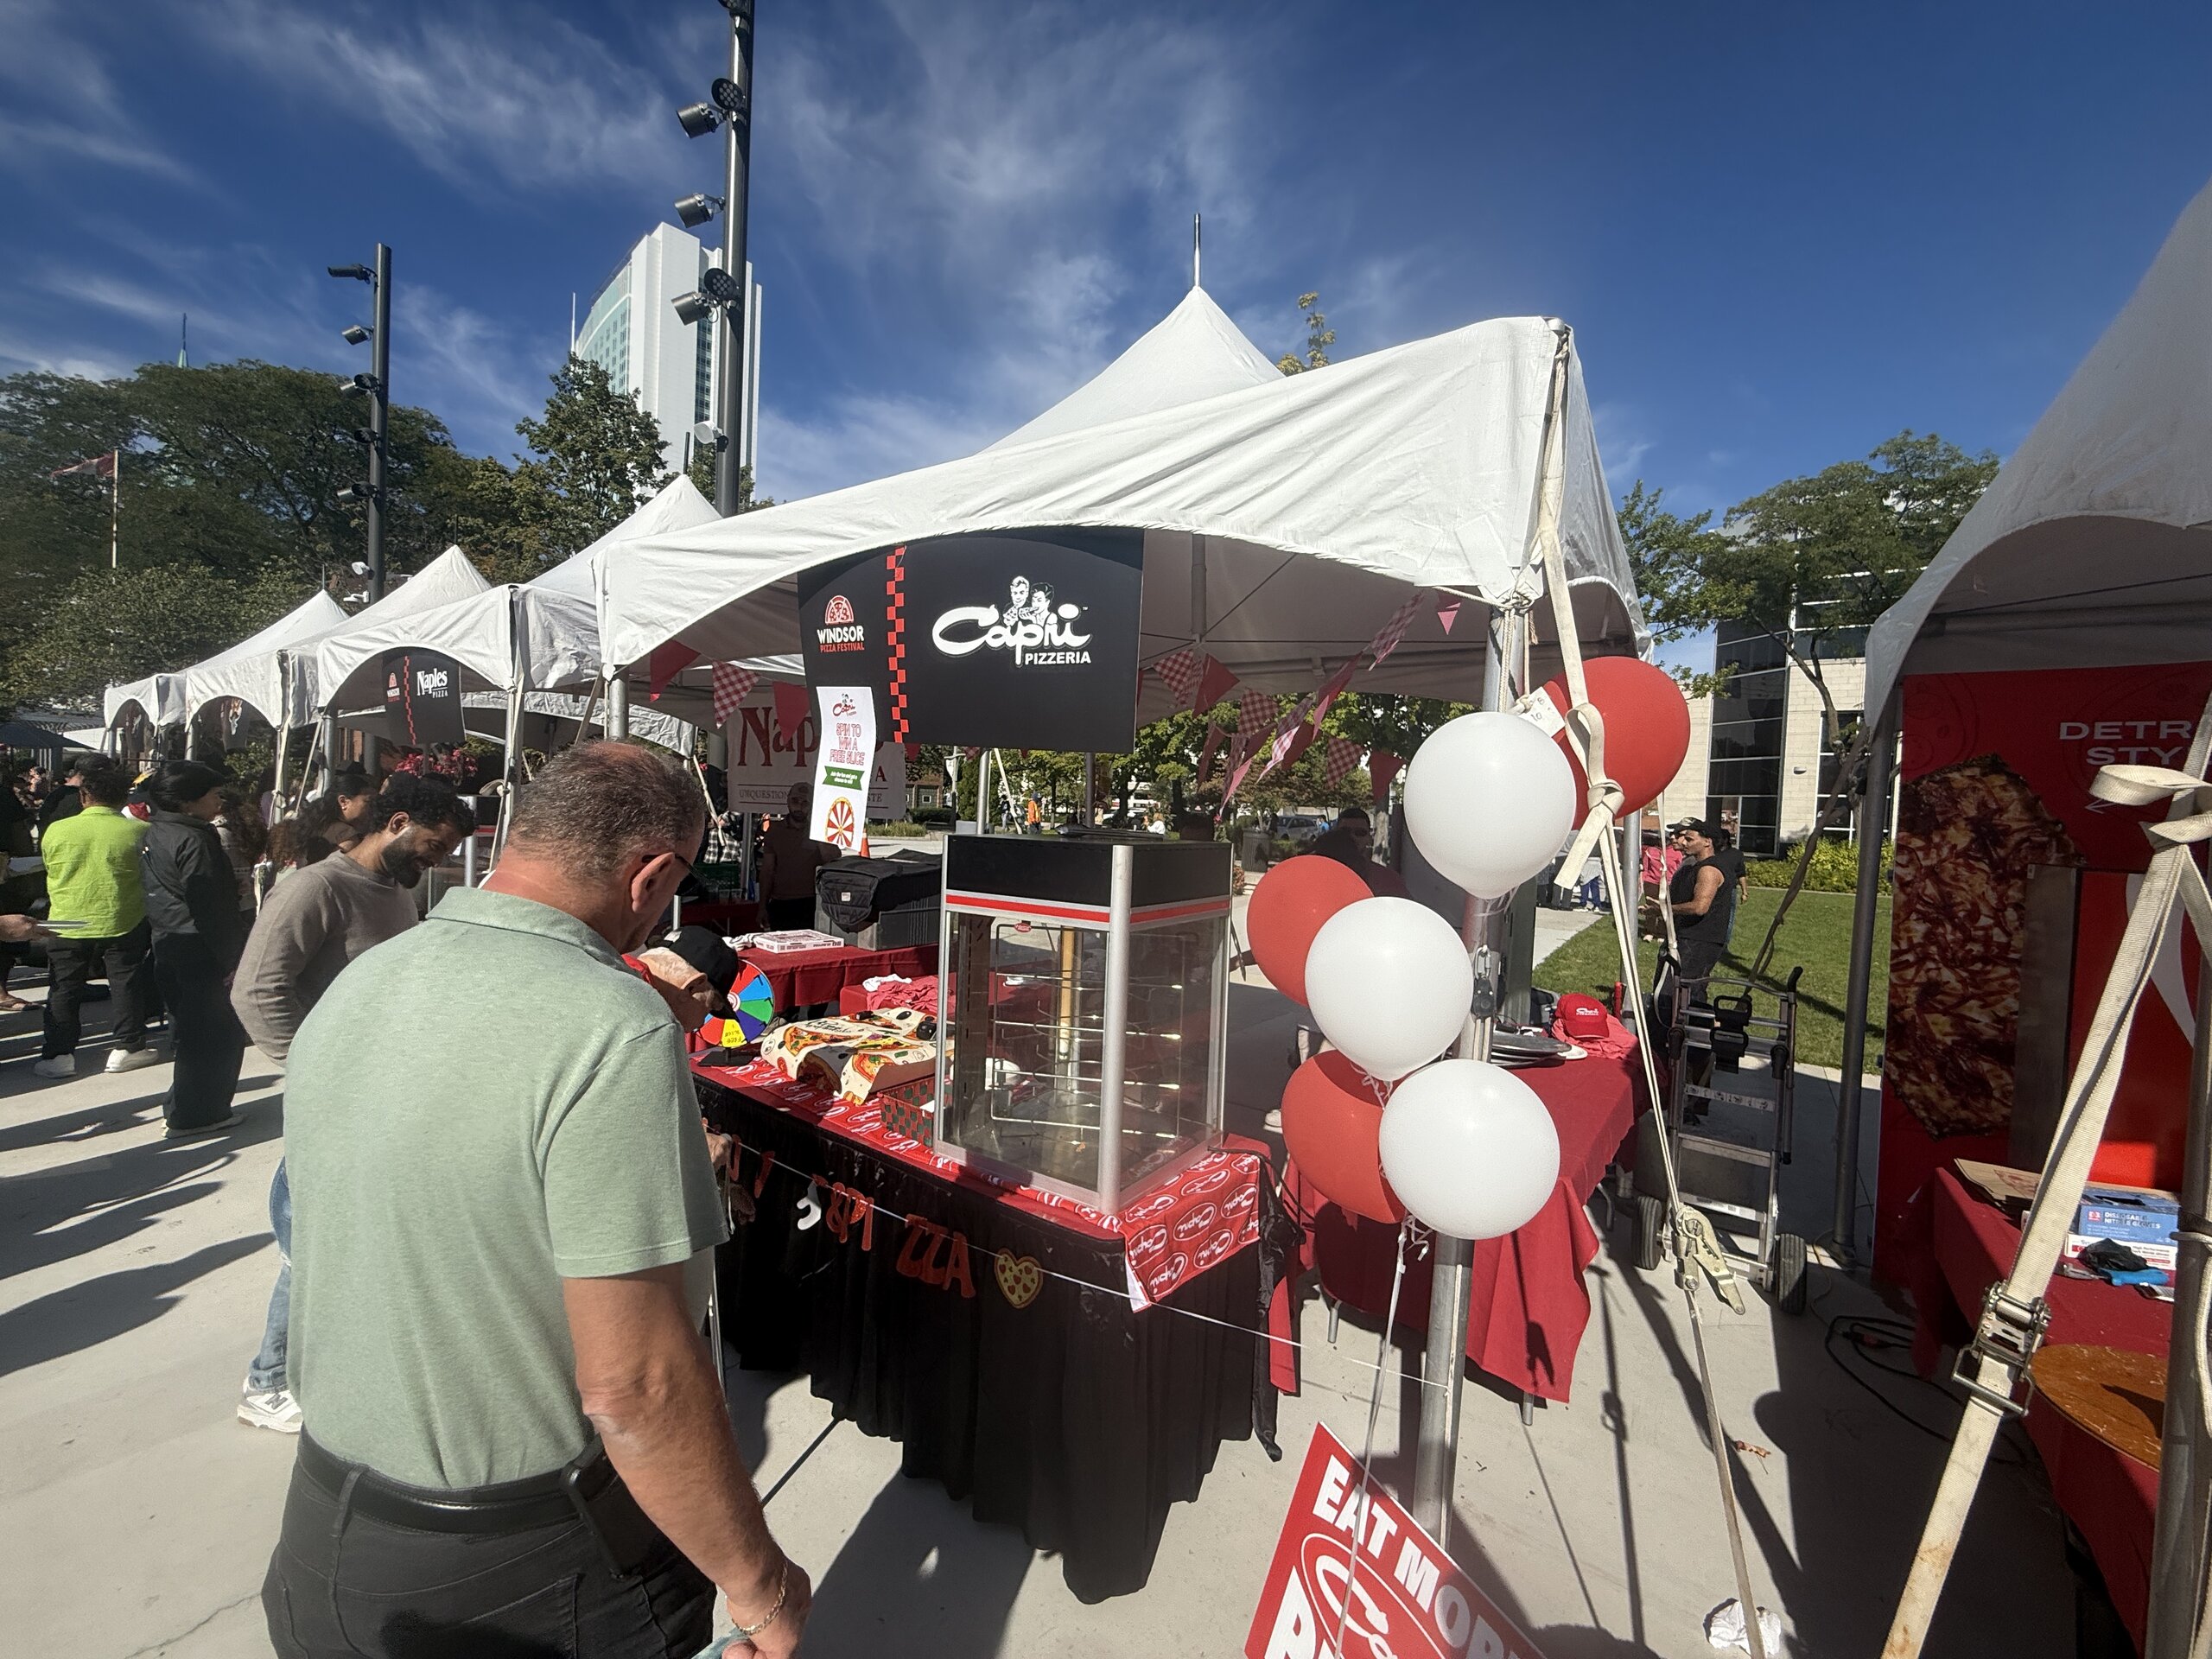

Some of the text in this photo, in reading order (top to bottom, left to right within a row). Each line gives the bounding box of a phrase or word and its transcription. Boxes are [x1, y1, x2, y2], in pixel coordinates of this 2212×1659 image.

[817, 626, 864, 644] WINDSOR
[932, 603, 1091, 664] Capri
[820, 642, 865, 653] PIZZA FESTIVAL
[1025, 651, 1091, 664] PIZZERIA
[416, 668, 448, 696] Naples
[850, 723, 861, 738] TO
[2059, 720, 2192, 740] DETR
[830, 749, 865, 766] FREE SLICE
[2086, 747, 2183, 765] STY
[1224, 1187, 1257, 1216] Capri
[1177, 1206, 1214, 1237] Capri
[2132, 1220, 2161, 1229] GLOVES
[1129, 1228, 1166, 1266] Capri
[1198, 1232, 1230, 1265] Capri
[1150, 1255, 1185, 1294] Capri
[1313, 1454, 1397, 1559] EAT
[1394, 1536, 1521, 1659] MOR
